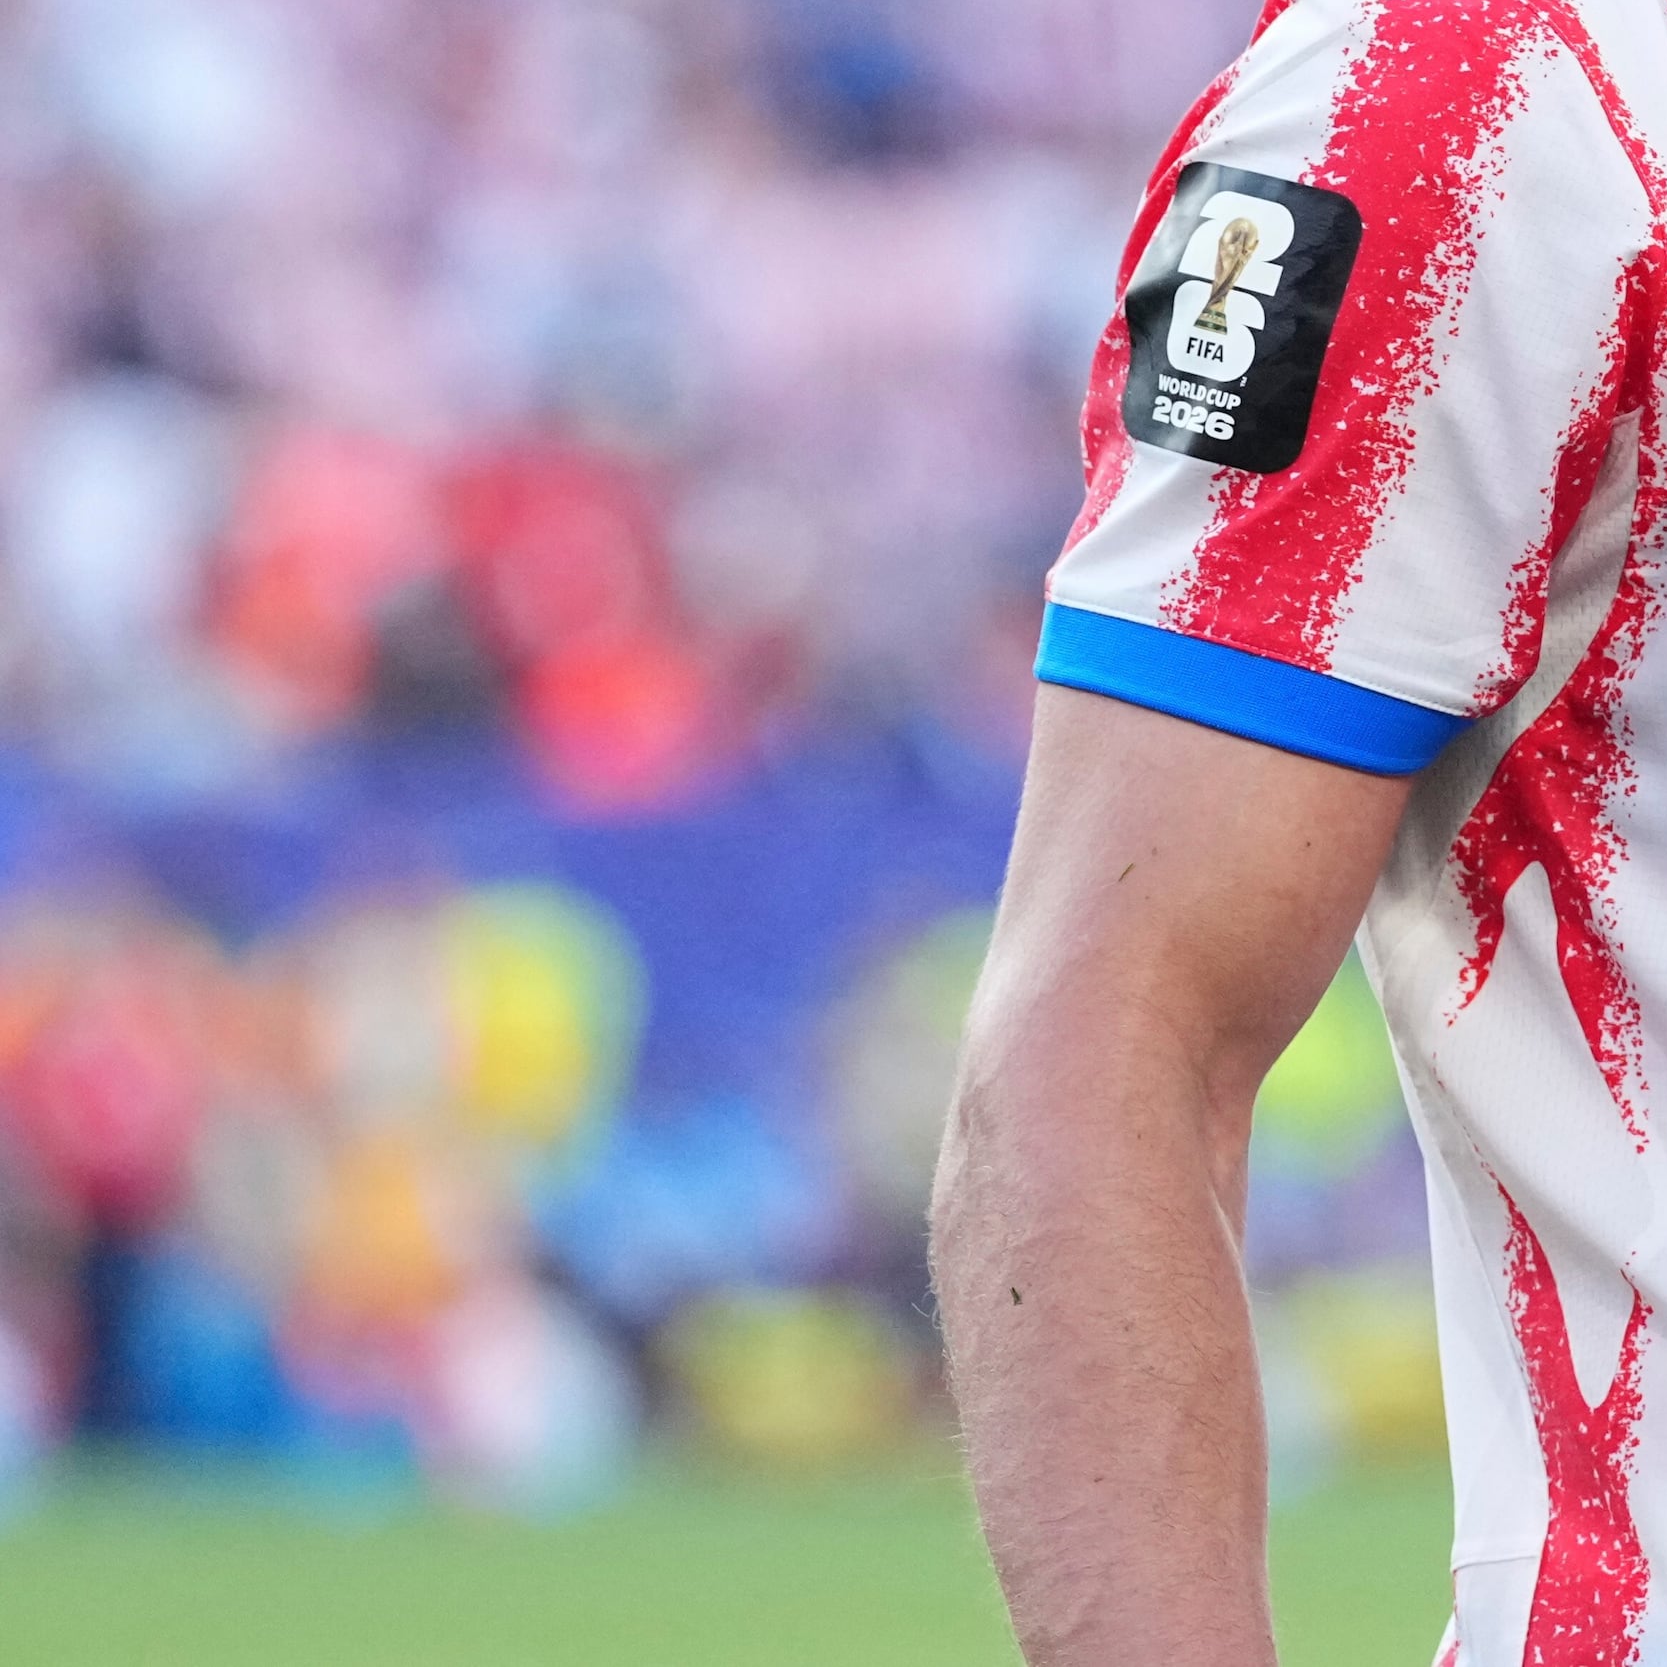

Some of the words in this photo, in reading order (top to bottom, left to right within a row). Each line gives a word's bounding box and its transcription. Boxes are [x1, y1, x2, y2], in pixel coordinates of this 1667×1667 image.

[1186, 337, 1223, 362] FIFA
[1158, 374, 1207, 401] WORLD
[1206, 388, 1241, 410] CUP
[1152, 395, 1235, 440] 2026
